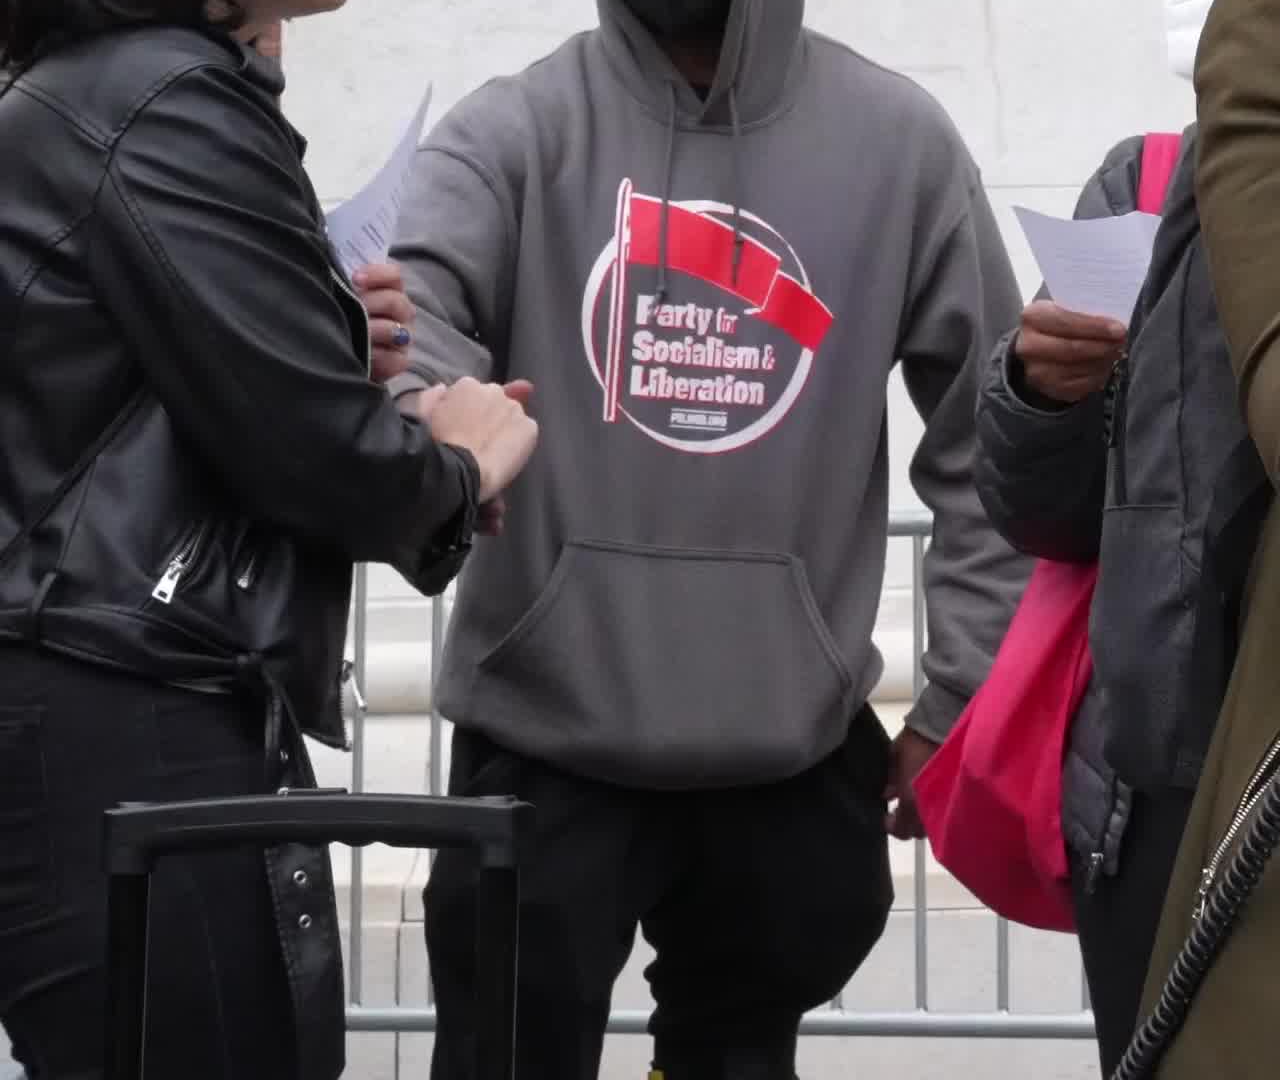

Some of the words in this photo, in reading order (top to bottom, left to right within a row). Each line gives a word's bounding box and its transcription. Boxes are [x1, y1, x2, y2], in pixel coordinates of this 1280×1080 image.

[636, 294, 712, 336] Party
[632, 330, 758, 370] Socialism
[630, 365, 764, 405] Liberation
